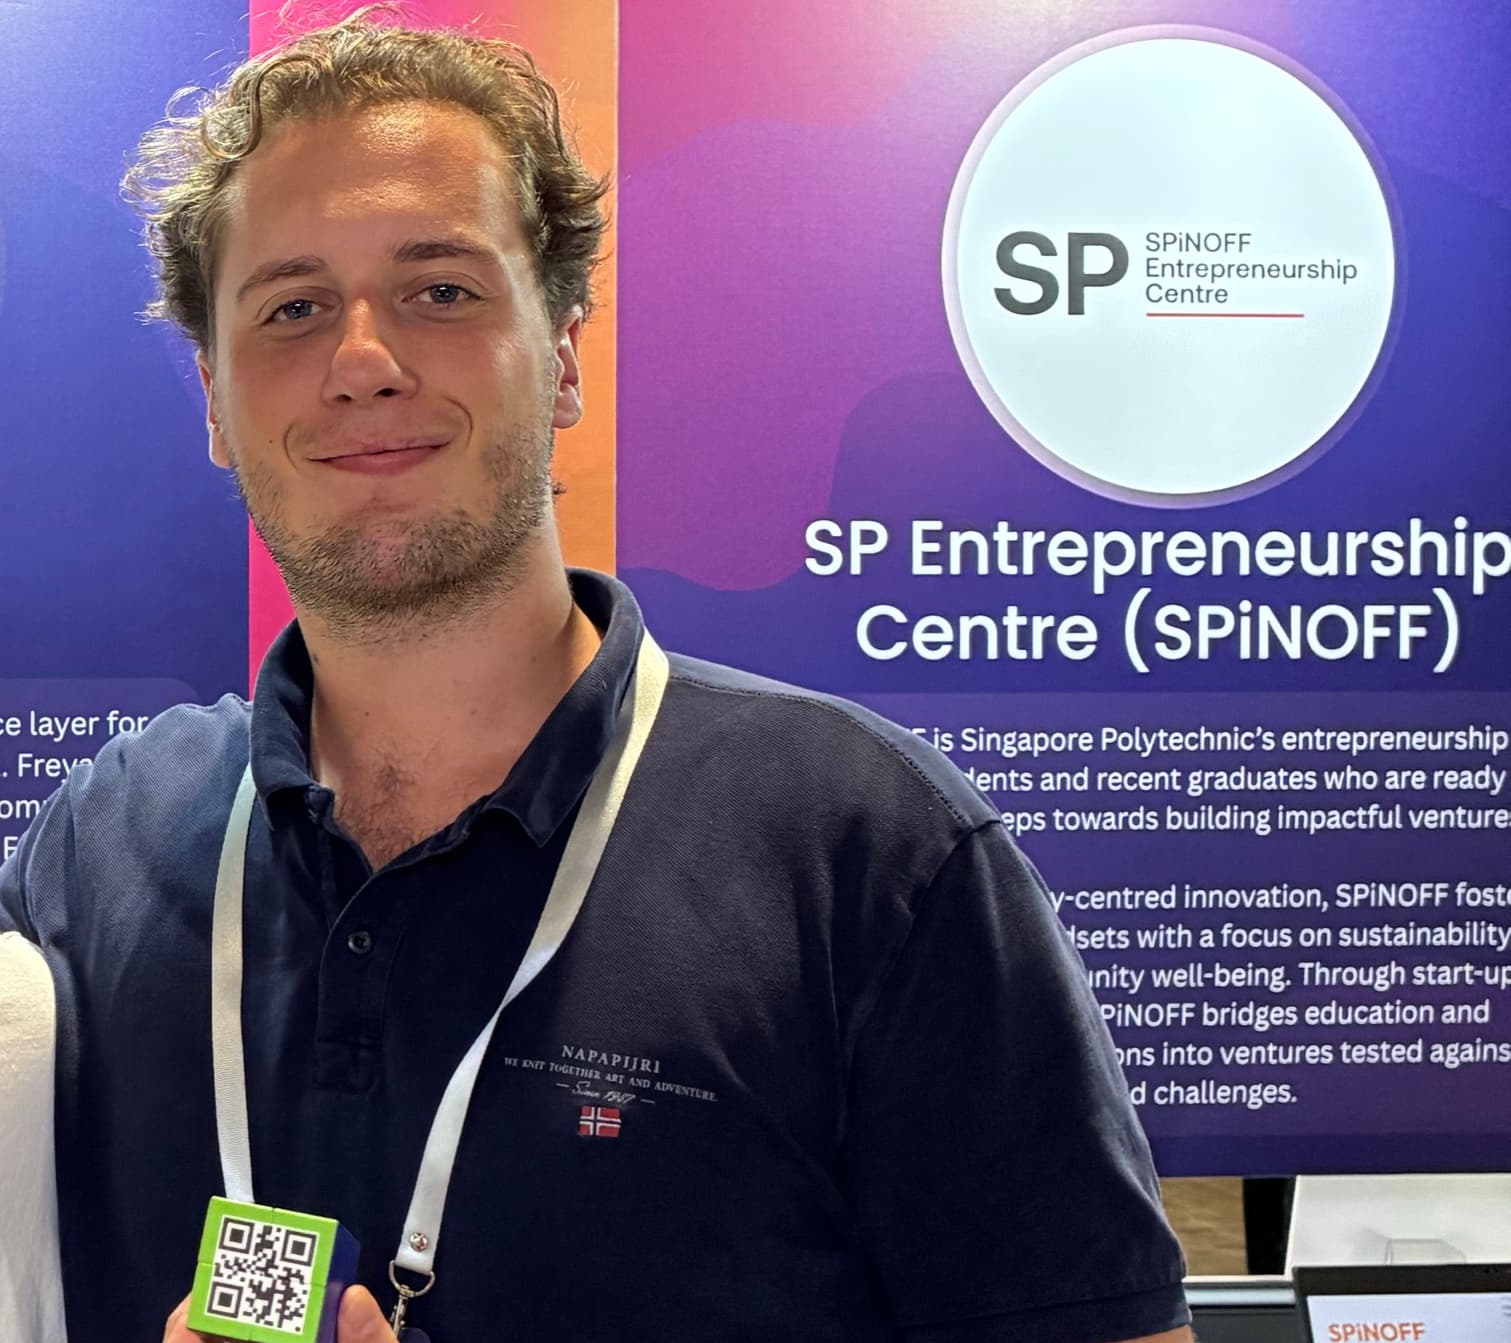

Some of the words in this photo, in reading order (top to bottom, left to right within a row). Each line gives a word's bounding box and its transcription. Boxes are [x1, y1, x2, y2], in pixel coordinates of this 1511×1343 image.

[1145, 232, 1251, 253] SPiNOFF
[994, 230, 1128, 315] SP
[1145, 258, 1358, 284] Entrepreneurship
[1145, 283, 1228, 304] Centre
[804, 520, 888, 576] SP
[912, 518, 1511, 594] Entrepreneurship
[857, 604, 1097, 660] Centre
[1125, 587, 1461, 674] (SPiNOFF)
[31, 711, 98, 742] layer
[107, 710, 148, 735] for
[934, 727, 954, 752] is
[961, 727, 1093, 758] Singapore
[1282, 725, 1509, 756] entrepreneurship
[1040, 767, 1089, 791] and
[1097, 770, 1181, 791] recent
[1187, 767, 1317, 796] graduates
[1323, 765, 1378, 790] who
[1385, 770, 1426, 790] are
[1433, 764, 1506, 796] ready
[1052, 807, 1158, 832] towards
[1166, 805, 1271, 835] building
[1278, 803, 1403, 834] impactful
[1408, 805, 1511, 829] venture
[1184, 884, 1328, 913] innovation,
[1335, 883, 1449, 908] SPiNOFF
[1137, 923, 1193, 948] with
[1199, 928, 1215, 948] a
[1220, 924, 1292, 948] focus
[1299, 928, 1332, 948] on
[1151, 963, 1292, 991] well-being.
[1299, 961, 1405, 992] Through
[1202, 1001, 1297, 1031] bridges
[1305, 999, 1434, 1025] education
[1441, 998, 1490, 1024] and
[561, 1044, 661, 1074] NAPAPIJRI
[1162, 1041, 1213, 1066] into
[1220, 1040, 1333, 1065] ventures
[1340, 1038, 1422, 1064] tested
[549, 1062, 601, 1080] TOGETHER
[605, 1072, 625, 1084] ART
[628, 1077, 651, 1088] AND
[1154, 1080, 1298, 1110] challenges.
[1328, 1322, 1425, 1342] SPiNOFF
